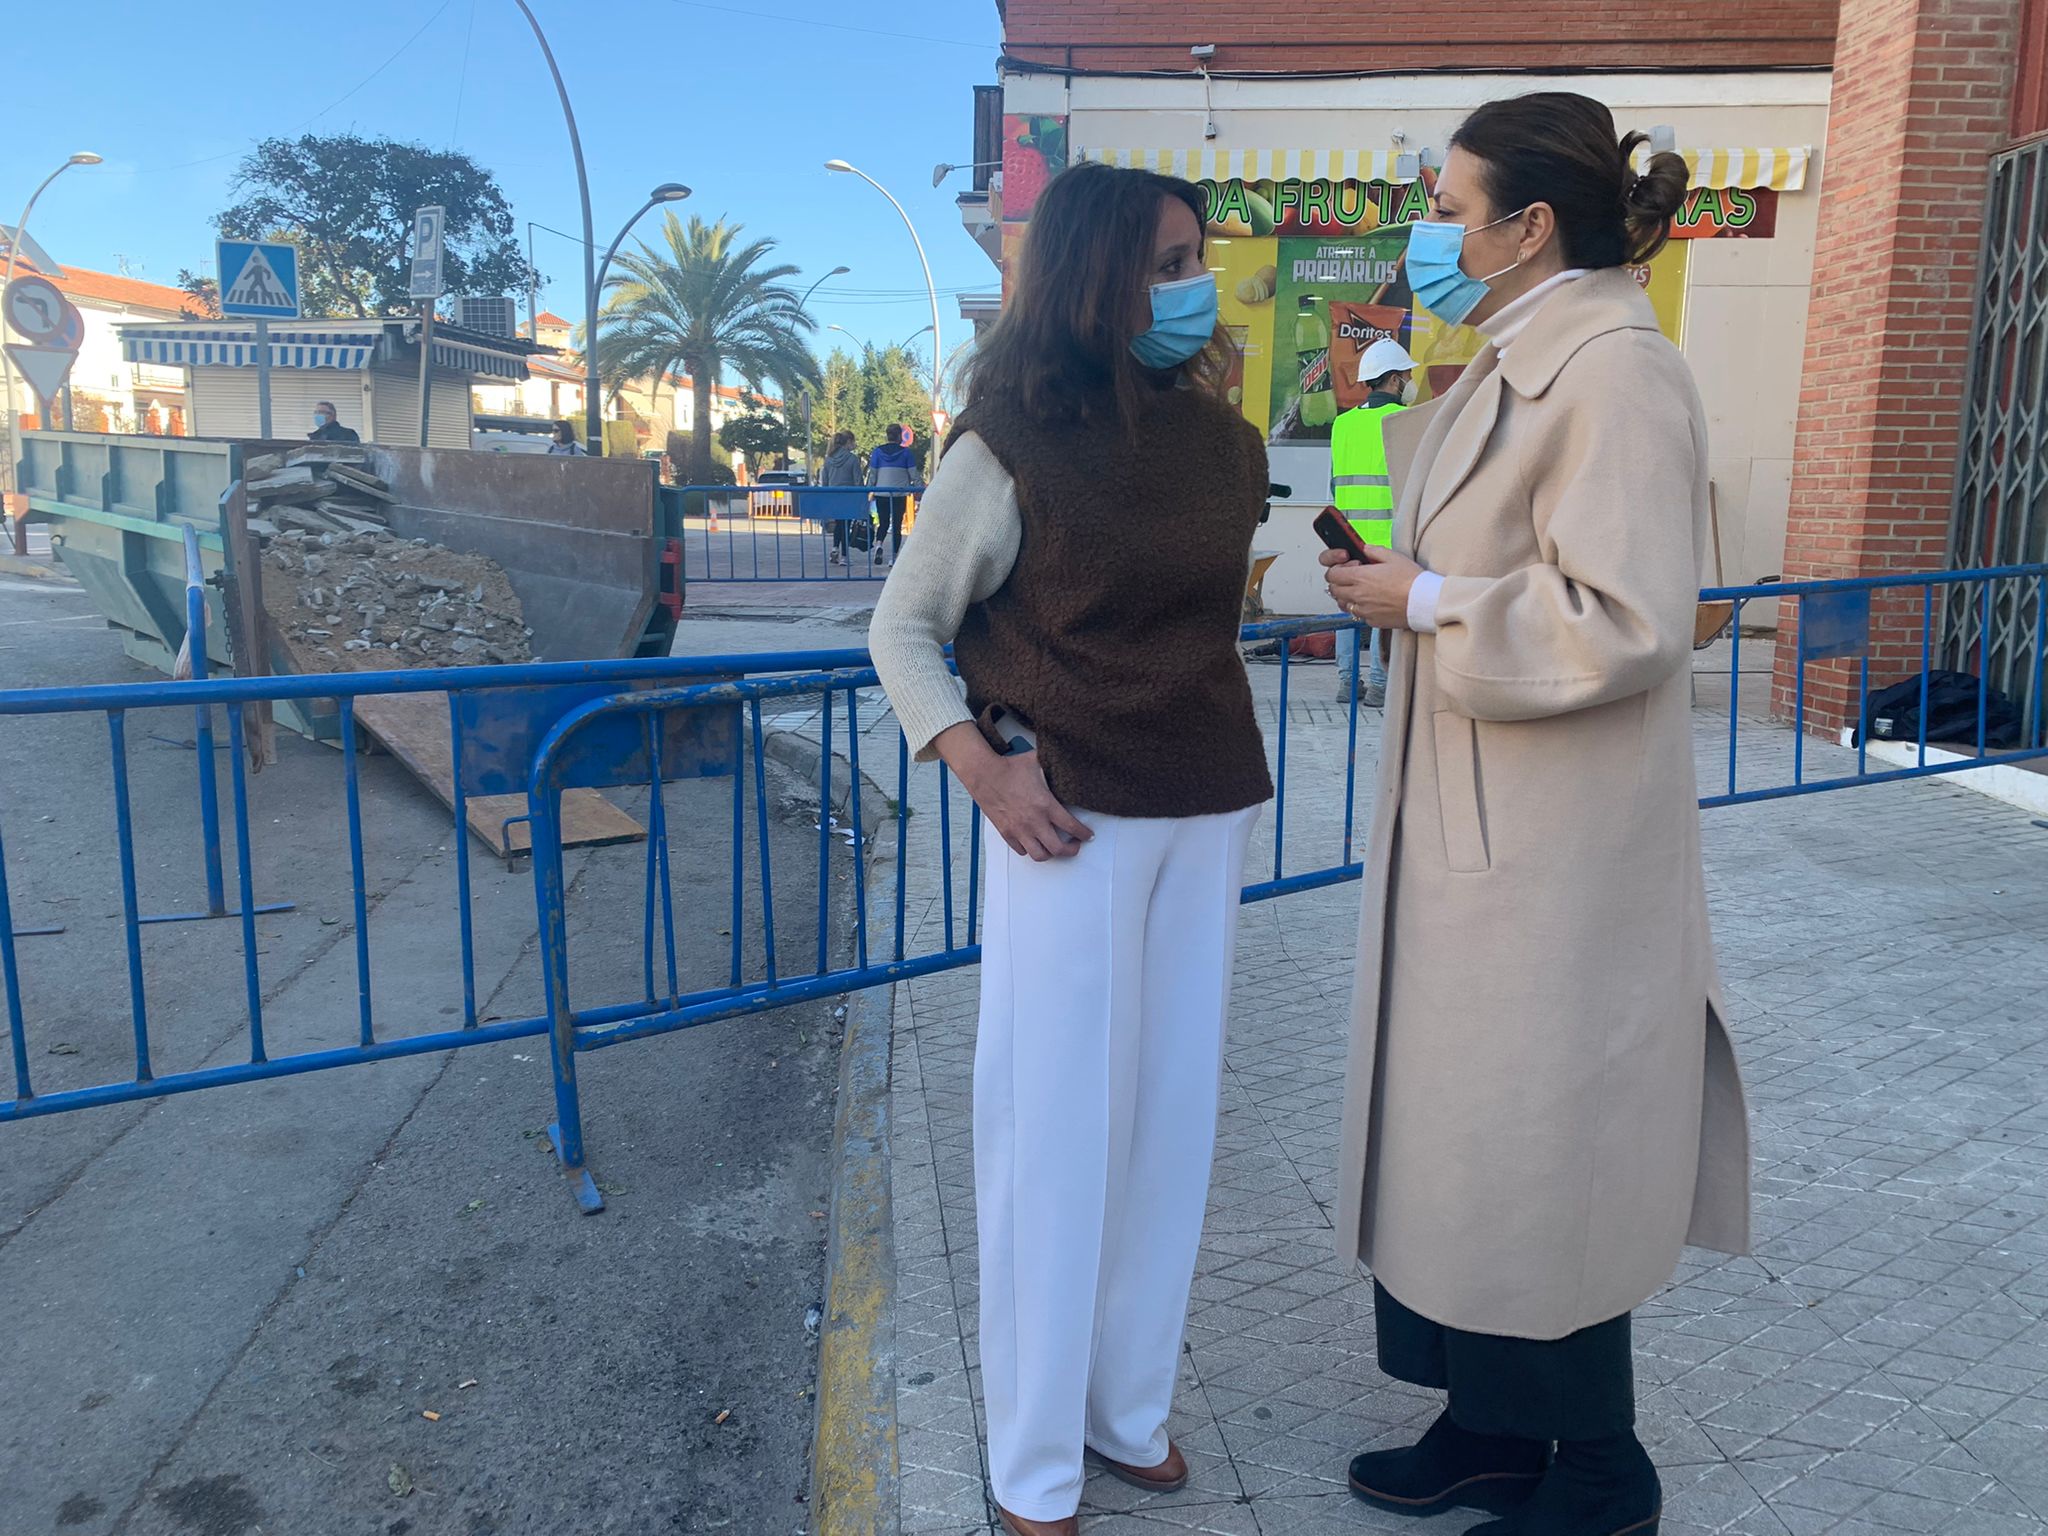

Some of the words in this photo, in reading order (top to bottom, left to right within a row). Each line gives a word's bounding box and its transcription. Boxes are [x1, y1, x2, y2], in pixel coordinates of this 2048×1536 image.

[418, 216, 434, 258] P
[1368, 246, 1376, 259] A
[1292, 260, 1398, 283] PROBARLOS
[1340, 323, 1392, 340] Doritos
